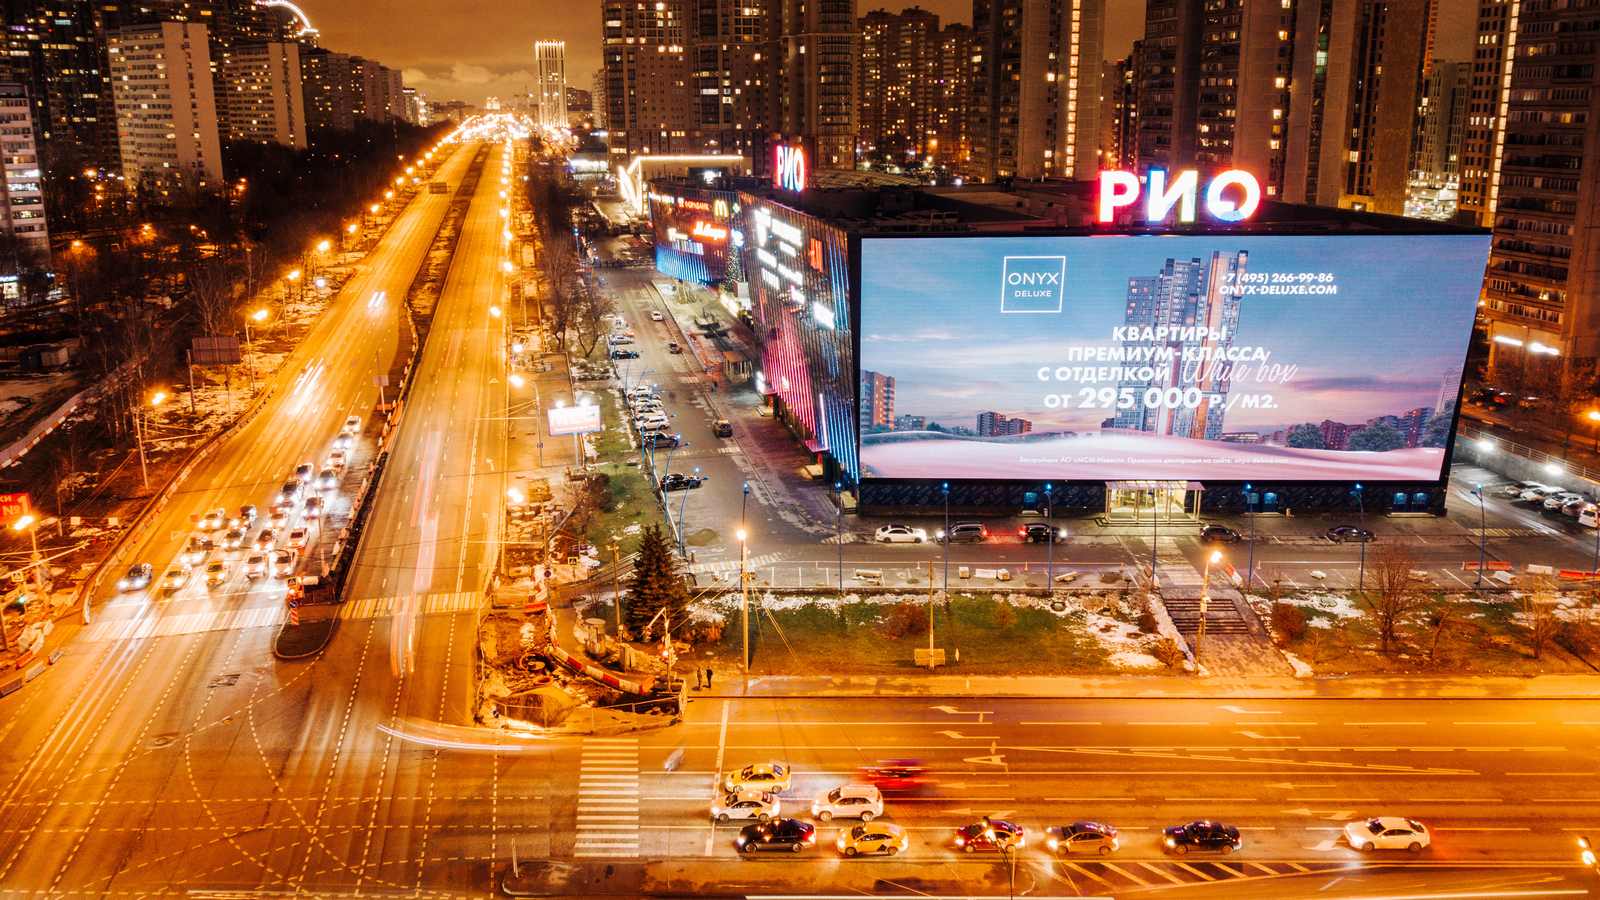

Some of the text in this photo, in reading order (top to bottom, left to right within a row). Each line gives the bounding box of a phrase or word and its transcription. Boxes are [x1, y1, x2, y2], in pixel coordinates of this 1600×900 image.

[777, 145, 804, 192] РИО
[1099, 170, 1260, 222] РИО
[1008, 272, 1059, 285] ONYX
[1220, 272, 1334, 284] +7 (495) 266-99-86
[1219, 285, 1337, 295] ONYX-DELUXE.COM
[1112, 327, 1226, 341] КВАРТИРЫ
[1068, 346, 1265, 362] ПРЕМИУМ-КЛАССА
[1037, 350, 1299, 383] С ОТДЕЛКОЙ White box
[1078, 387, 1135, 409] 295
[1143, 387, 1203, 409] 000
[1018, 456, 1059, 464] Застройщик
[1163, 457, 1201, 465] декларация
[1212, 456, 1233, 464] сайте:
[1234, 457, 1289, 465] onyx-deluxe.com
